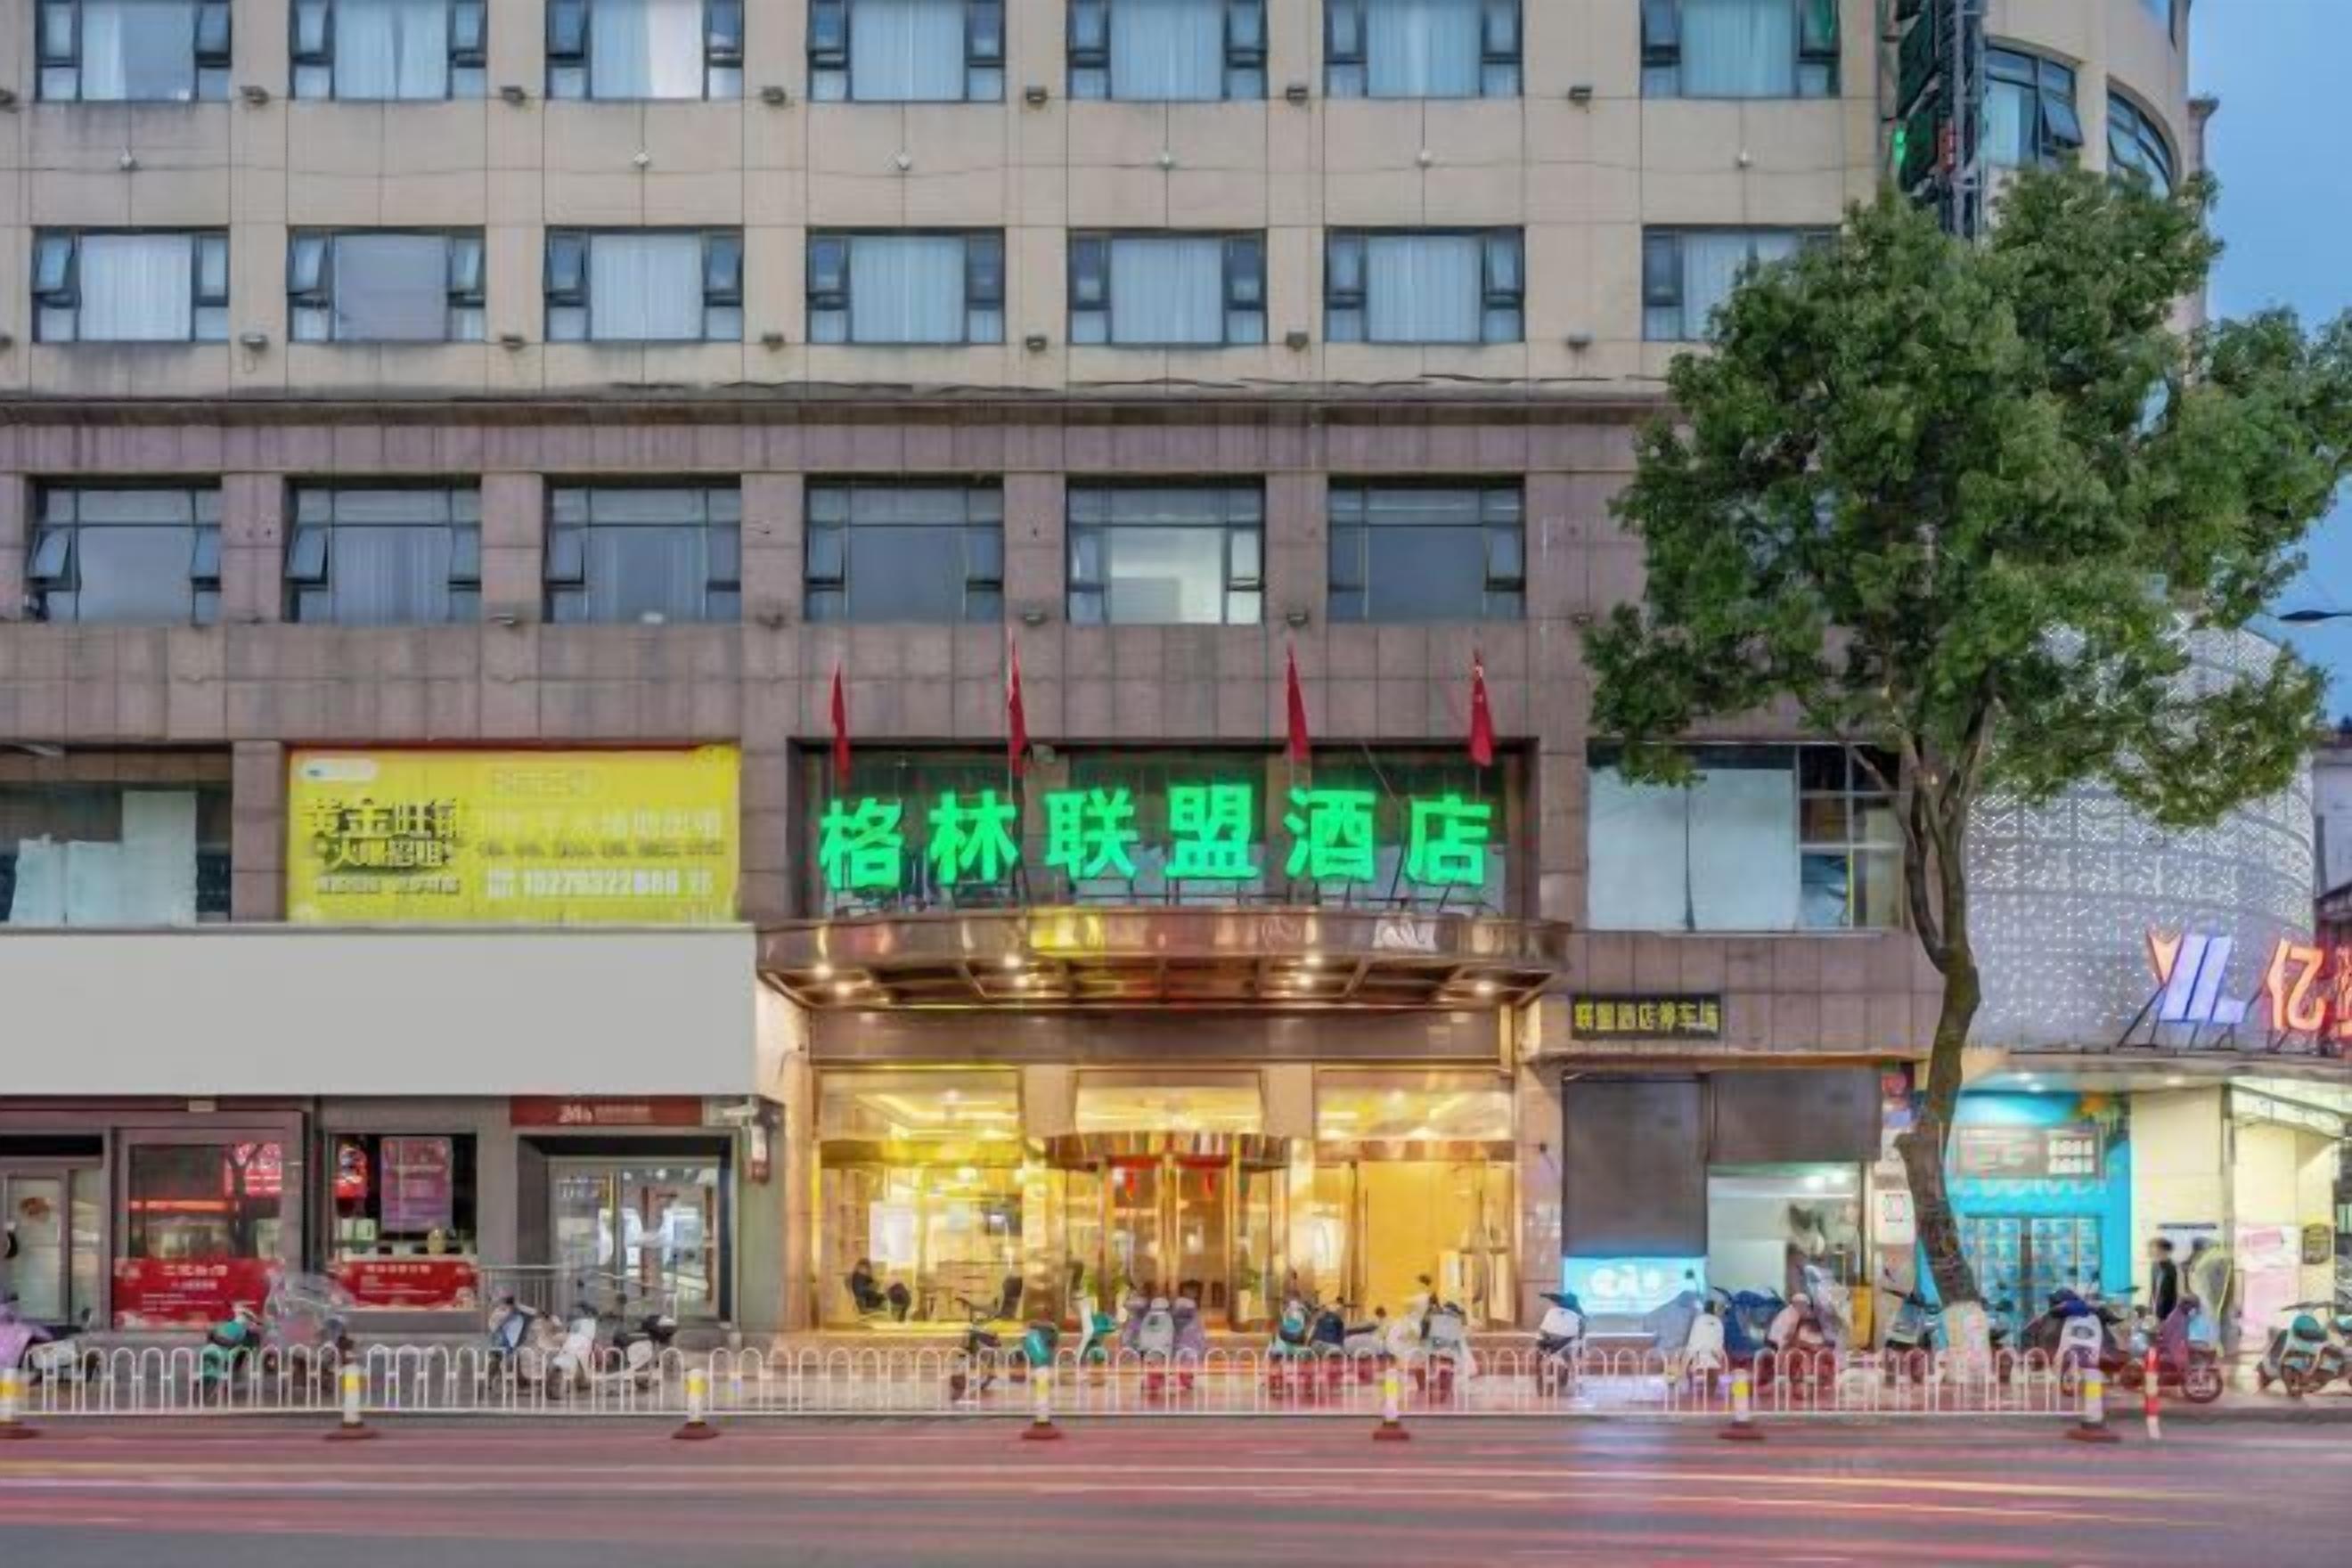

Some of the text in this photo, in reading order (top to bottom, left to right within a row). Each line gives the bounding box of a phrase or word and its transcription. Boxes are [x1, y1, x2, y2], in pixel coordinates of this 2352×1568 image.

[819, 784, 1491, 889] 格林联盟酒店
